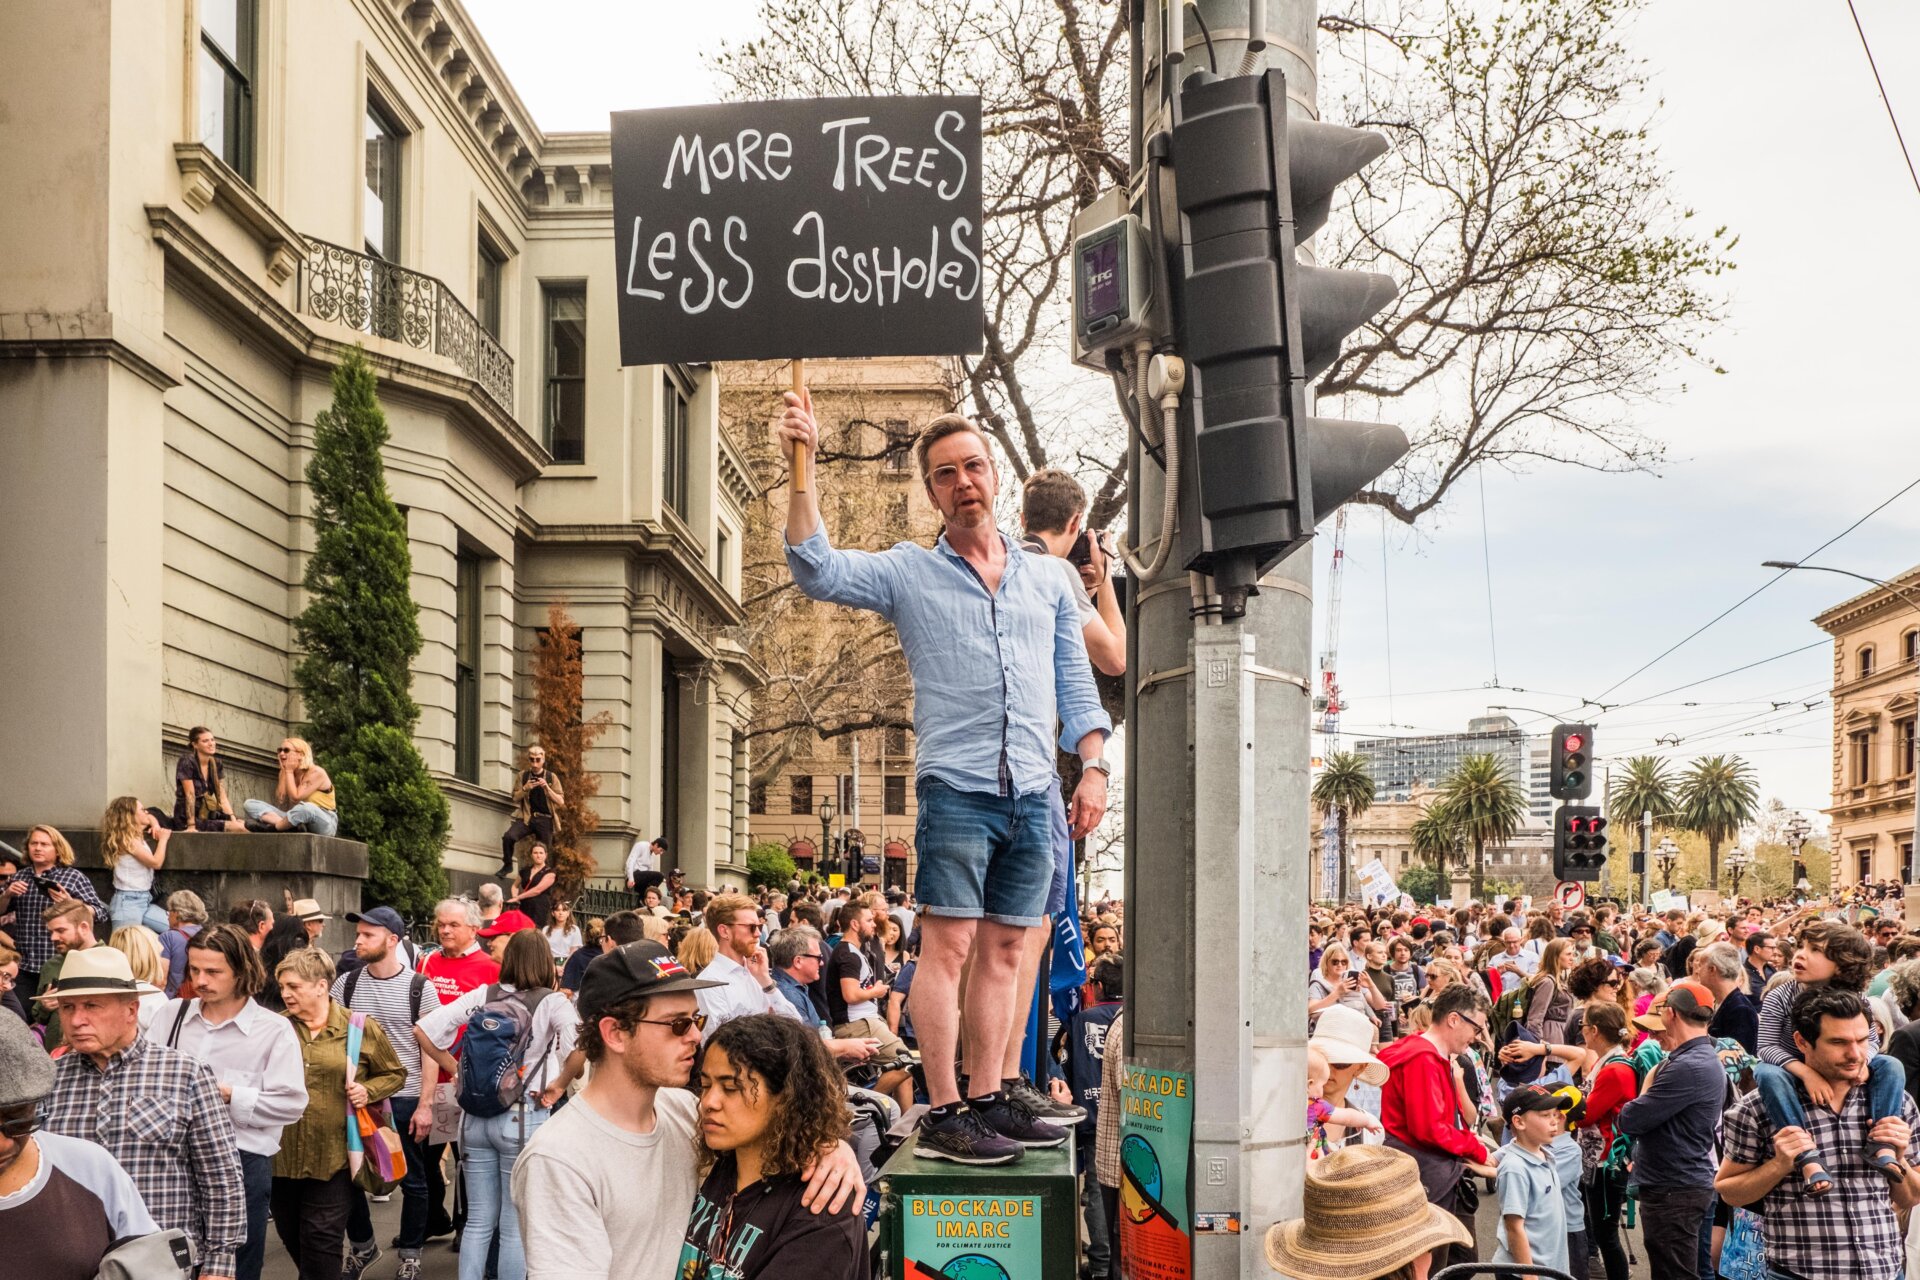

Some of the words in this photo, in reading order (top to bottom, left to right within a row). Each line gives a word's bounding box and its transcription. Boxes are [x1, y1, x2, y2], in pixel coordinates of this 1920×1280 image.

[822, 110, 968, 201] TREES
[1122, 1072, 1187, 1098] CKADE
[912, 1199, 1034, 1217] BLOCKADE
[936, 1220, 1010, 1239] IMARC
